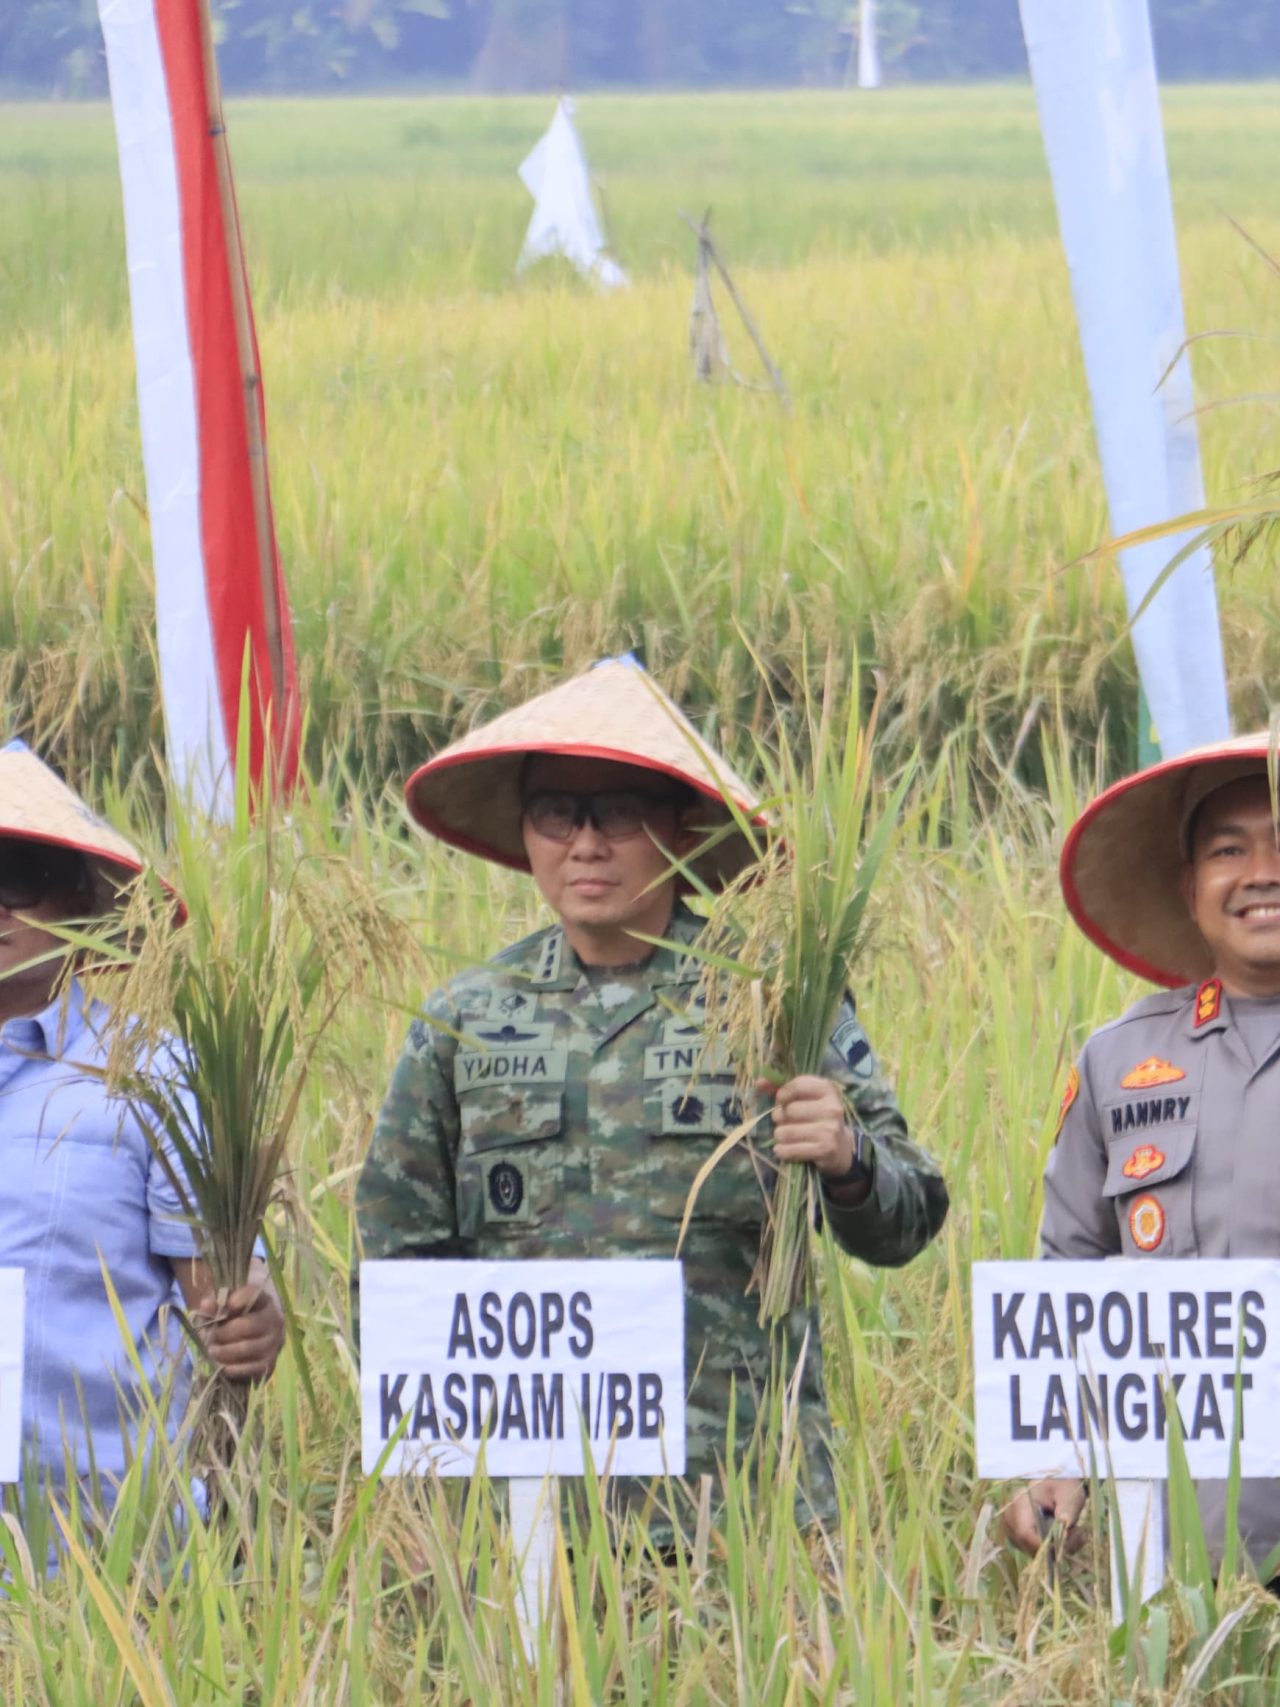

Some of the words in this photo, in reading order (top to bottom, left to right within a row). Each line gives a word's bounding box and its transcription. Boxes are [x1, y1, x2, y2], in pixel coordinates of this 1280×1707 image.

[463, 1056, 547, 1081] YUDHA
[1111, 1096, 1191, 1134] HANNRY
[447, 1291, 594, 1360] ASOPS
[992, 1290, 1267, 1360] KAPOLRES
[379, 1372, 565, 1440] KASDAM
[581, 1371, 665, 1440] I/BB
[1010, 1373, 1253, 1441] LANGKAT
